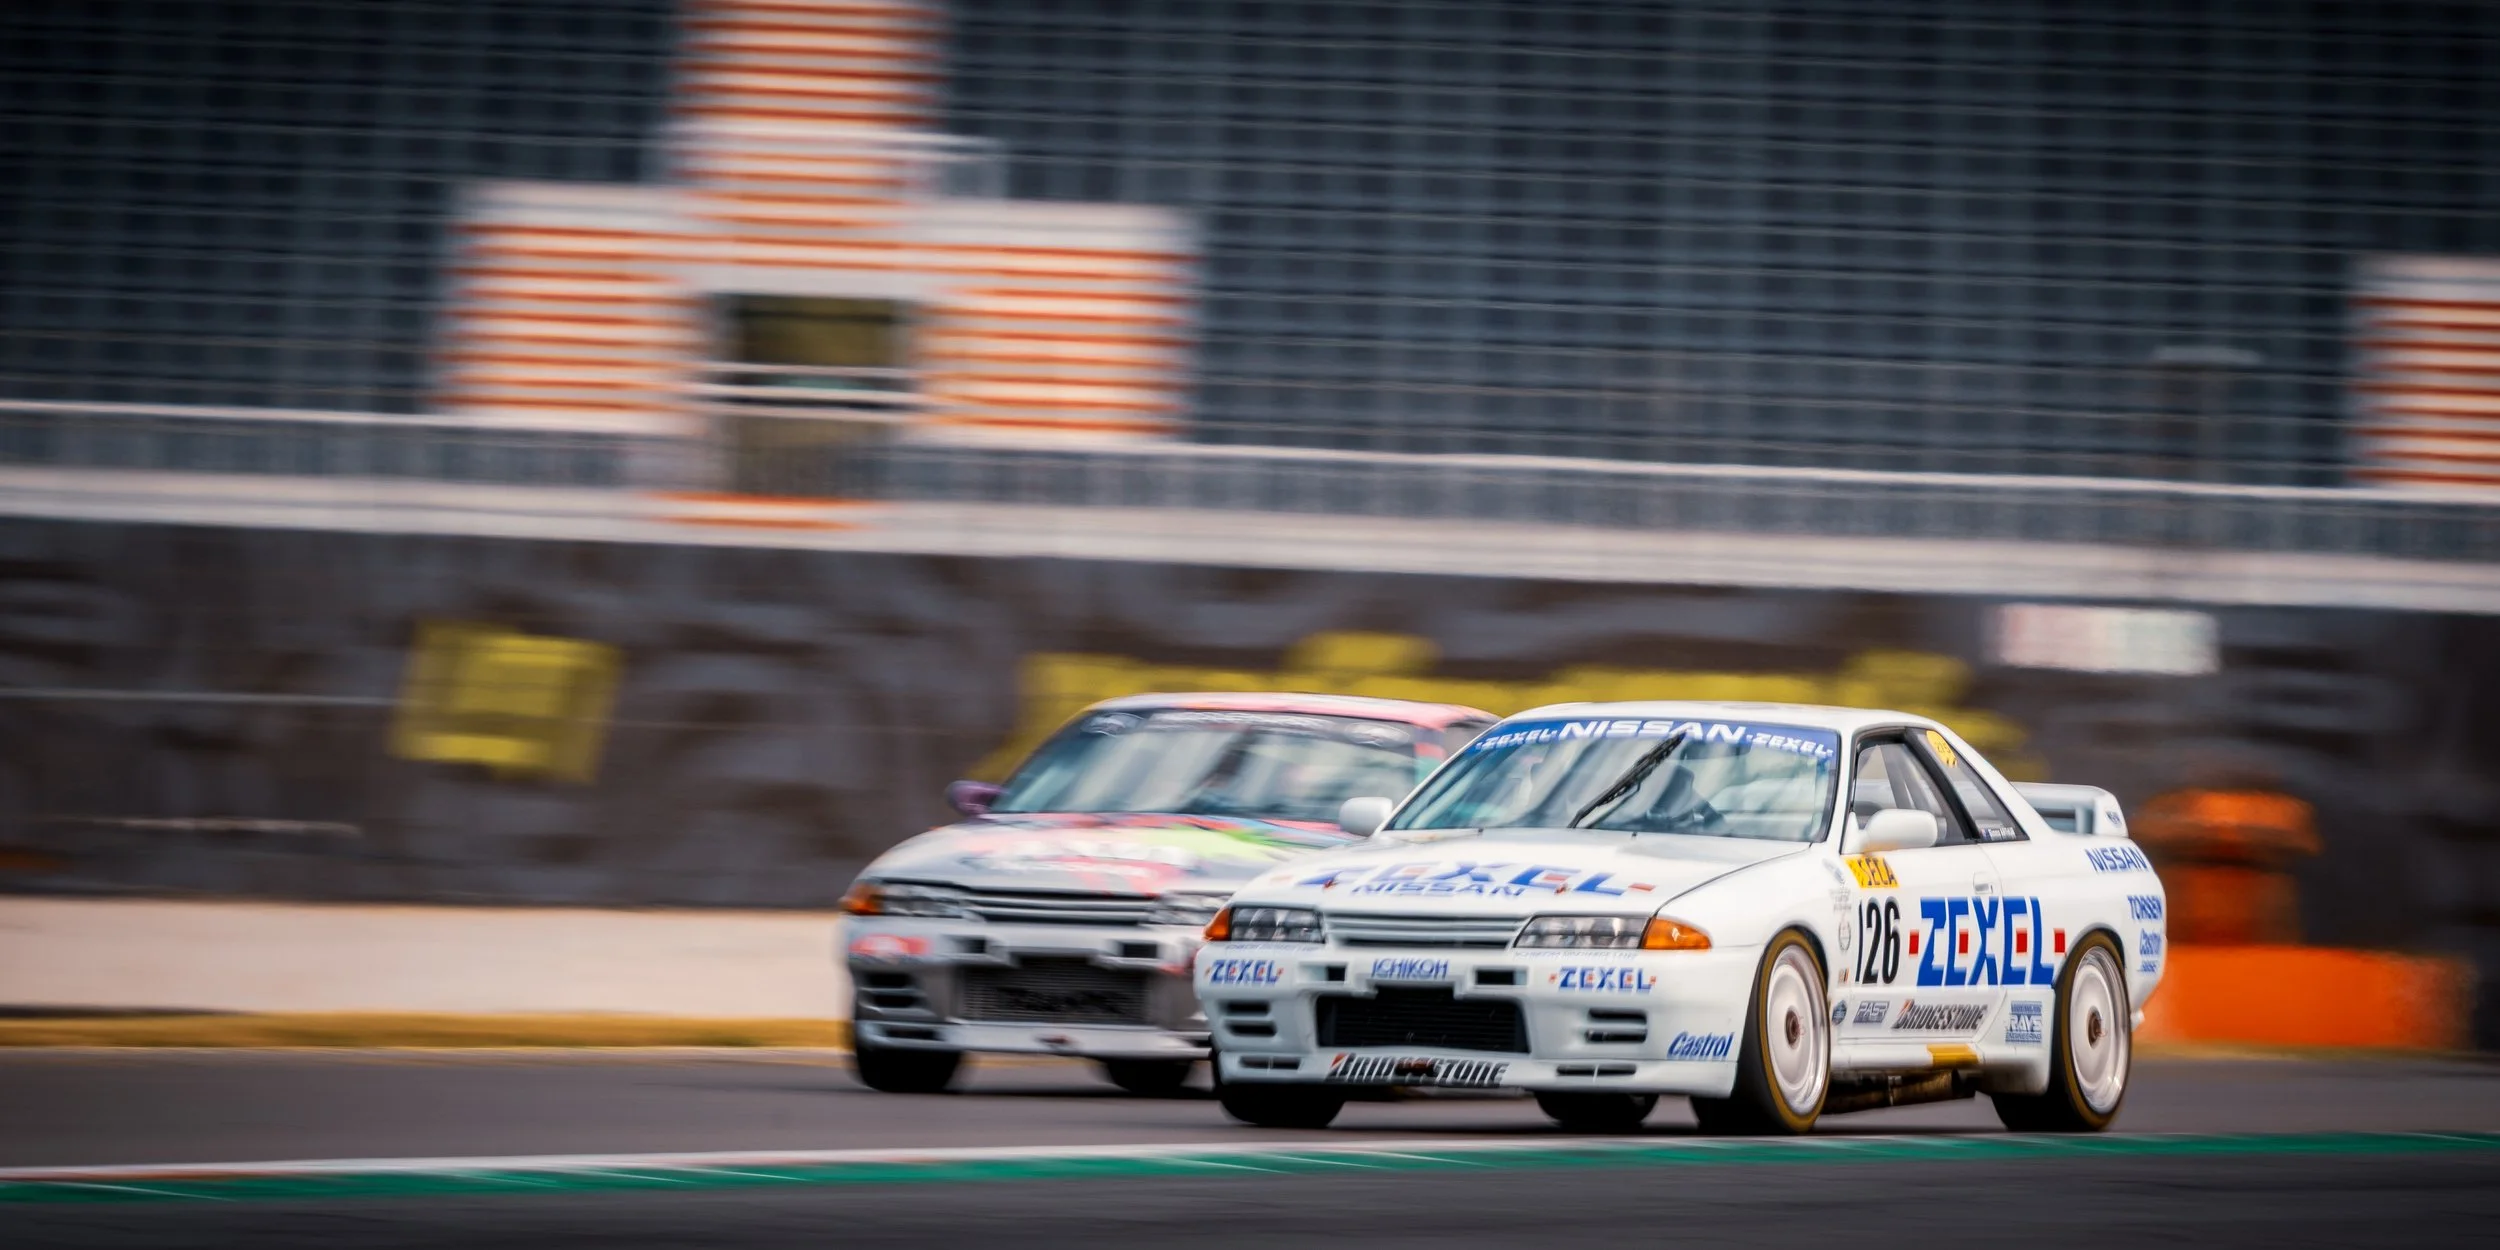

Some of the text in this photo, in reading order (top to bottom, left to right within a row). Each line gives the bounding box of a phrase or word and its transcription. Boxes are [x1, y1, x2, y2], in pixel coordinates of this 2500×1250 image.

[1481, 721, 1828, 760] ZEXEL NISSAN ZEXEL
[2085, 847, 2148, 873] NISSAN
[1855, 896, 1901, 985] 126
[1917, 896, 2055, 986] ZEXEL
[1209, 959, 1279, 987] ZEXEL
[1371, 958, 1450, 981] ICHIKOH
[1559, 966, 1654, 992] ZEXEL
[1891, 999, 1989, 1031] BRIDGESTONE
[1667, 1031, 1734, 1060] Castrol
